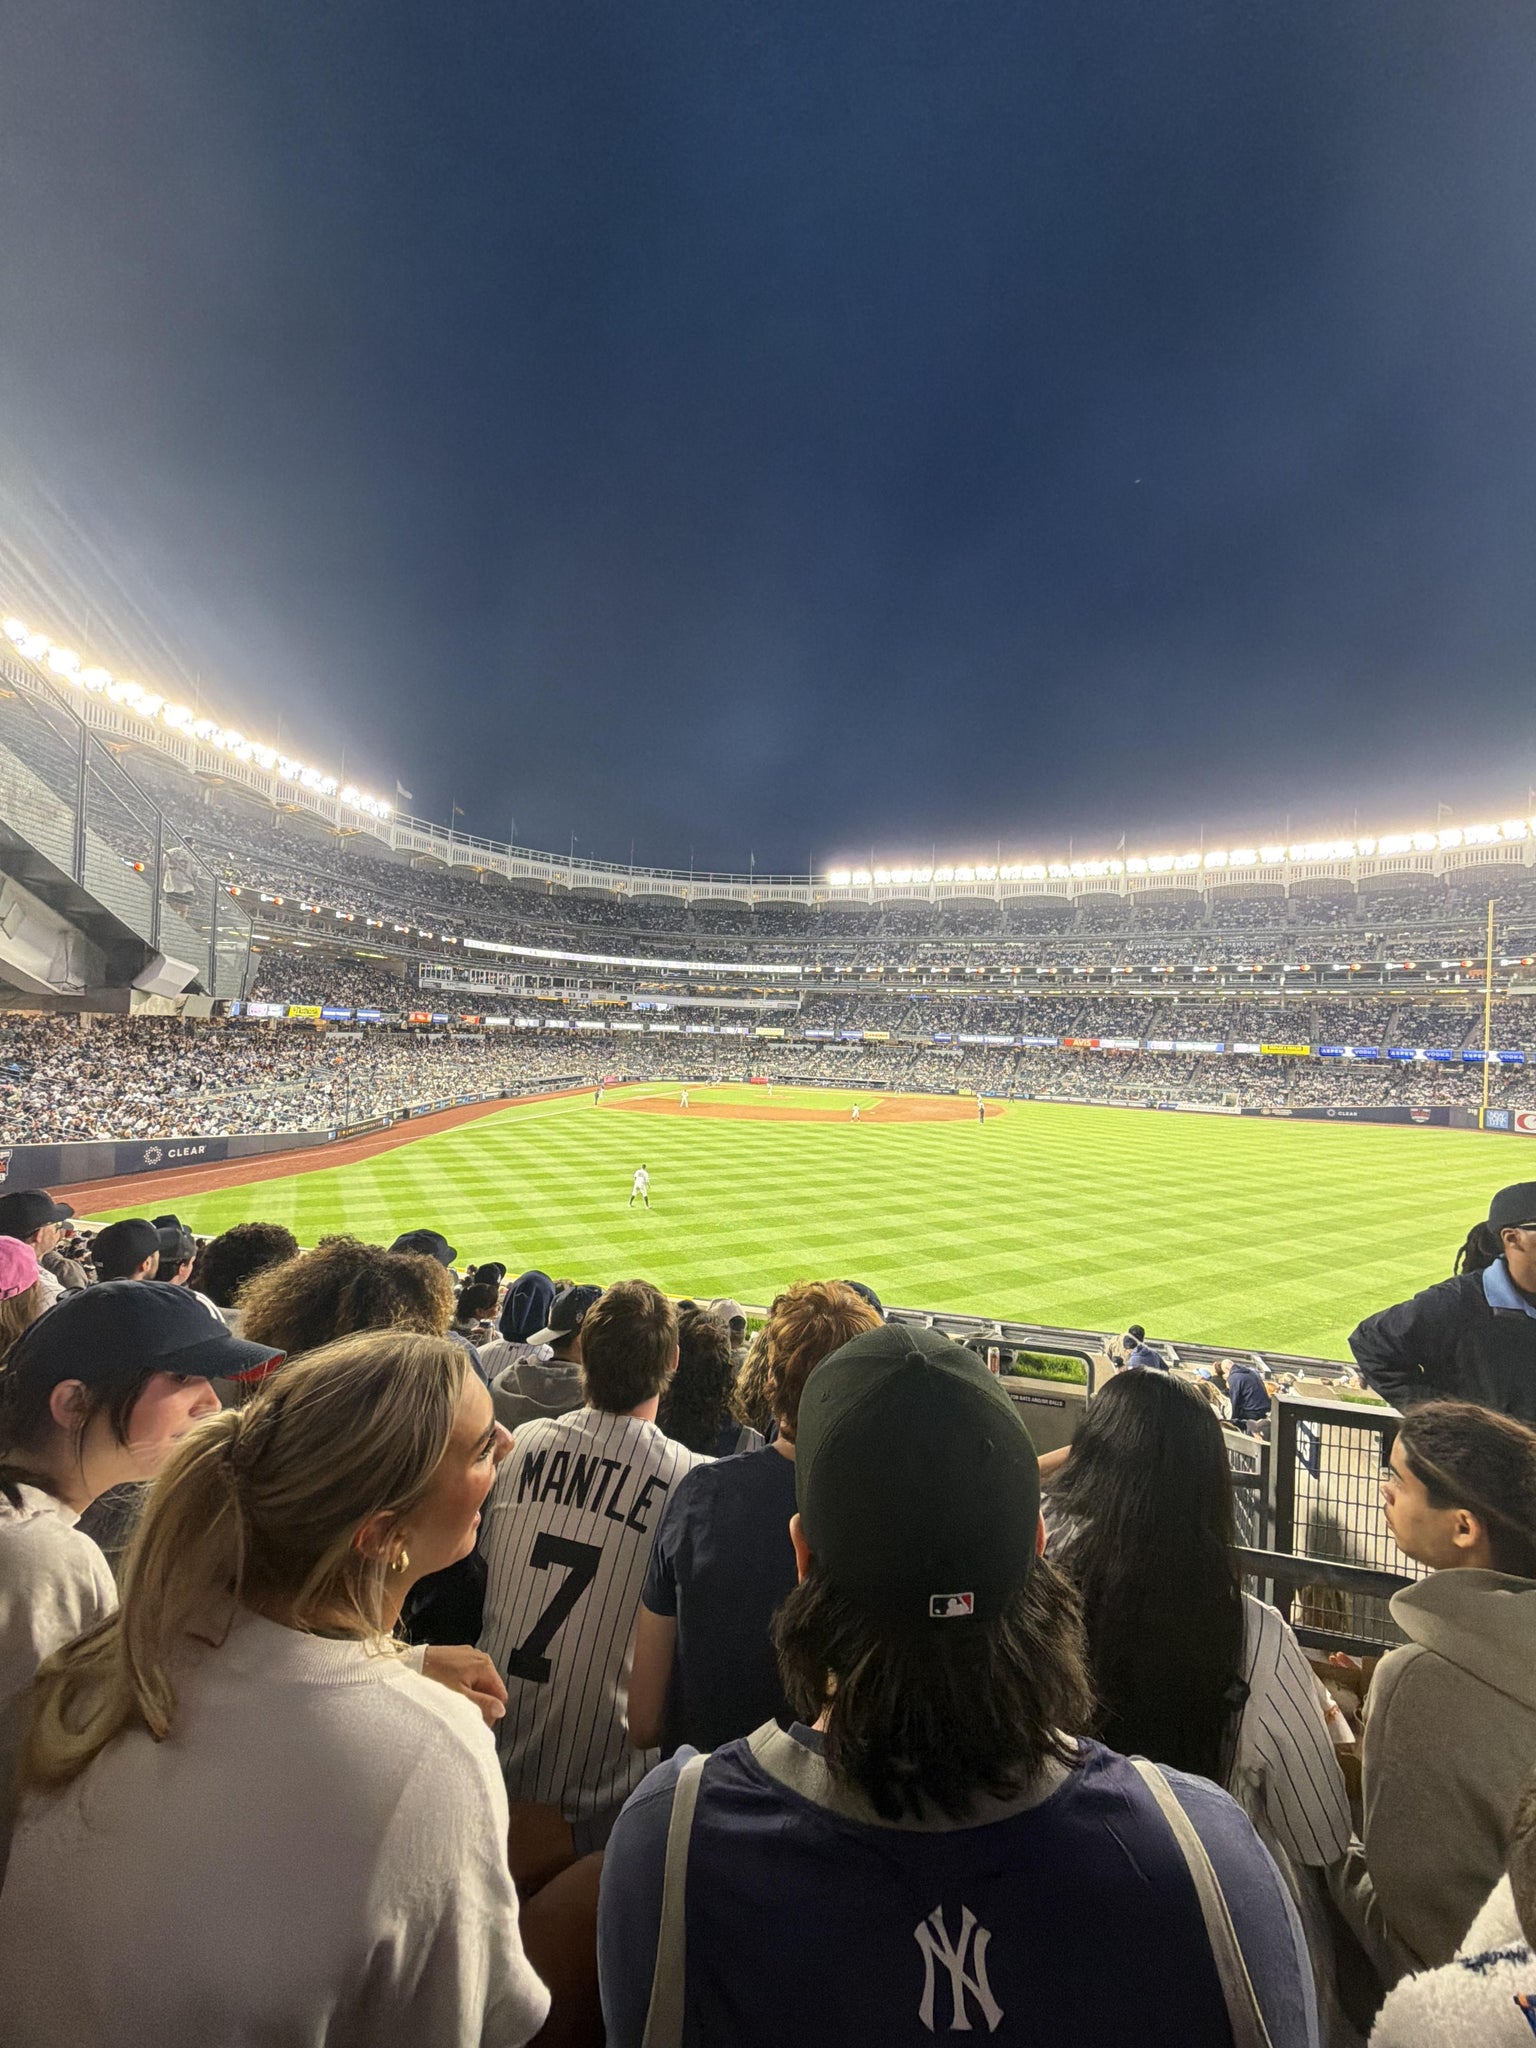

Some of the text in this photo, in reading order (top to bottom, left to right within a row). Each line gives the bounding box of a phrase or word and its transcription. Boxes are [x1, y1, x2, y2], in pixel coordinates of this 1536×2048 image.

[168, 1146, 205, 1158] CLEAR
[517, 1451, 670, 1534] MANTLE
[507, 1531, 603, 1683] 7
[914, 1904, 1004, 2033] NY
